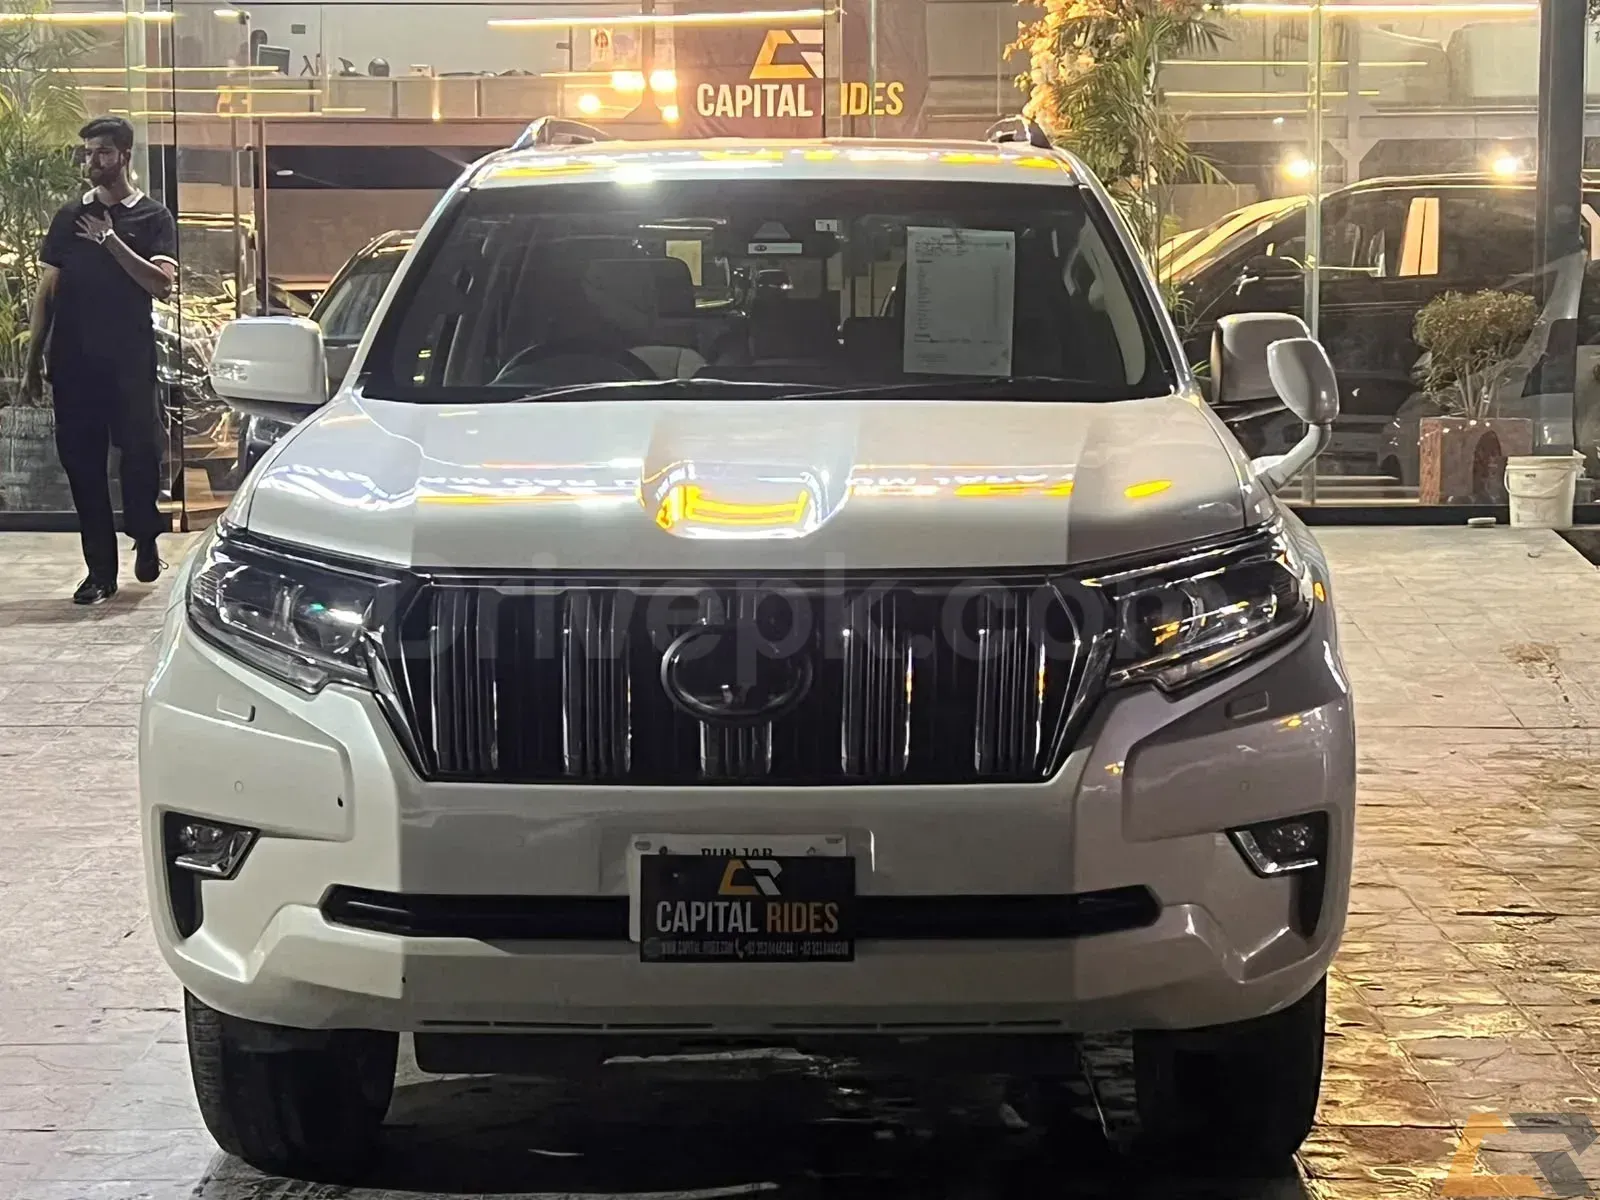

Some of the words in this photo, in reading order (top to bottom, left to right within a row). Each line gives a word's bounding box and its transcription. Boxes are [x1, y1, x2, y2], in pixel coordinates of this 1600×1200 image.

[696, 83, 814, 117] CAPITAL
[821, 81, 904, 116] IDES
[656, 900, 758, 933] CAPITAL
[766, 902, 839, 933] RIDES
